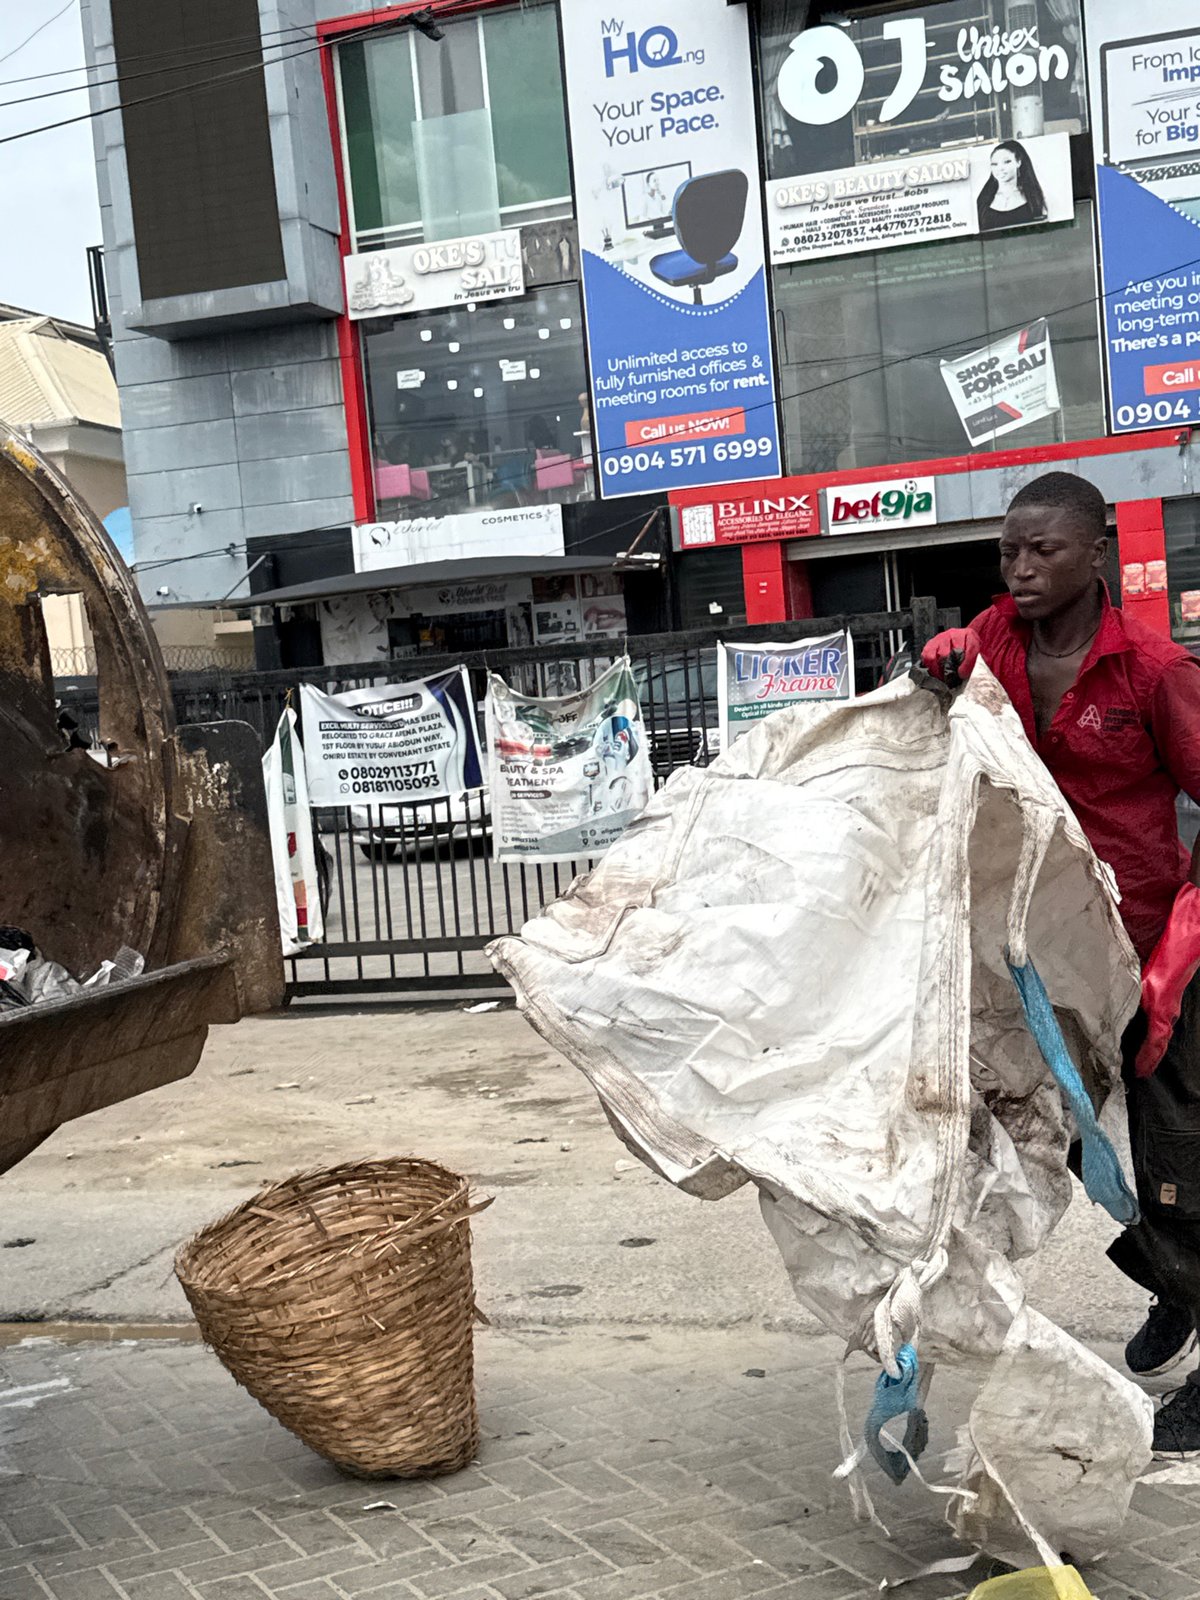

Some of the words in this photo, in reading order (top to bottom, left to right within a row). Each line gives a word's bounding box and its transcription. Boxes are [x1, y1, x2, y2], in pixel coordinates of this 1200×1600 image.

[601, 18, 624, 36] My
[957, 24, 1040, 63] Unisex
[1132, 51, 1183, 71] From
[593, 99, 644, 122] Your
[651, 86, 724, 115] Space.
[1146, 107, 1190, 125] Your
[602, 125, 653, 147] Your
[660, 113, 719, 138] Pace.
[1136, 128, 1162, 146] for
[1166, 122, 1199, 142] Big
[776, 181, 829, 208] OKE'S
[833, 170, 906, 199] BEAUTY
[907, 160, 970, 187] SALON
[810, 204, 820, 212] In
[822, 200, 852, 211] Jesus
[413, 241, 485, 274] OKE'S
[464, 290, 490, 299] Jesus
[1124, 281, 1153, 296] Are
[1156, 275, 1187, 294] you
[1114, 292, 1183, 314] meeting
[1118, 310, 1199, 332] long-term
[1111, 333, 1168, 353] There's
[1171, 333, 1182, 345] a
[607, 348, 678, 372] Unlimited
[681, 343, 729, 360] access
[732, 341, 748, 354] to
[596, 375, 625, 391] fully
[628, 364, 696, 386] furnished
[700, 357, 747, 376] offices
[751, 355, 763, 368] &
[956, 356, 1000, 383] SHOP
[1162, 368, 1194, 386] Call
[597, 388, 657, 409] meeting
[661, 382, 707, 399] rooms
[710, 378, 730, 392] for
[733, 373, 769, 389] rent.
[962, 370, 1005, 399] FOR
[1116, 398, 1191, 426] 0904
[640, 419, 666, 440] Call
[669, 424, 686, 436] us
[604, 451, 665, 476] 0904
[670, 445, 706, 467] 571
[713, 437, 773, 462] 6999
[717, 494, 812, 518] BLINX
[832, 484, 932, 522] bet9ja
[481, 512, 543, 525] COSMETICS
[717, 515, 763, 527] ACCESSORIES
[776, 509, 814, 520] ELEGANCE
[735, 648, 842, 683] LICKER
[756, 674, 837, 700] Frame
[404, 717, 420, 726] HAS
[421, 712, 441, 722] BEEN
[322, 732, 358, 740] RELOCATED
[359, 732, 368, 740] TO
[369, 731, 393, 740] GRACE
[394, 729, 418, 738] ARENA
[419, 722, 446, 734] PLAZA,
[335, 742, 356, 750] FLOOR
[356, 742, 365, 750] BY
[366, 741, 387, 750] YUSUF
[387, 738, 422, 749] ABIODUN
[423, 732, 443, 743] WAY,
[347, 752, 368, 760] ESTATE
[368, 752, 377, 760] BY
[378, 747, 423, 759] CONVENANT
[424, 741, 451, 752] ESTATE
[350, 760, 436, 780] 08029113771
[542, 766, 564, 775] SPA
[352, 774, 440, 794] 08181105093
